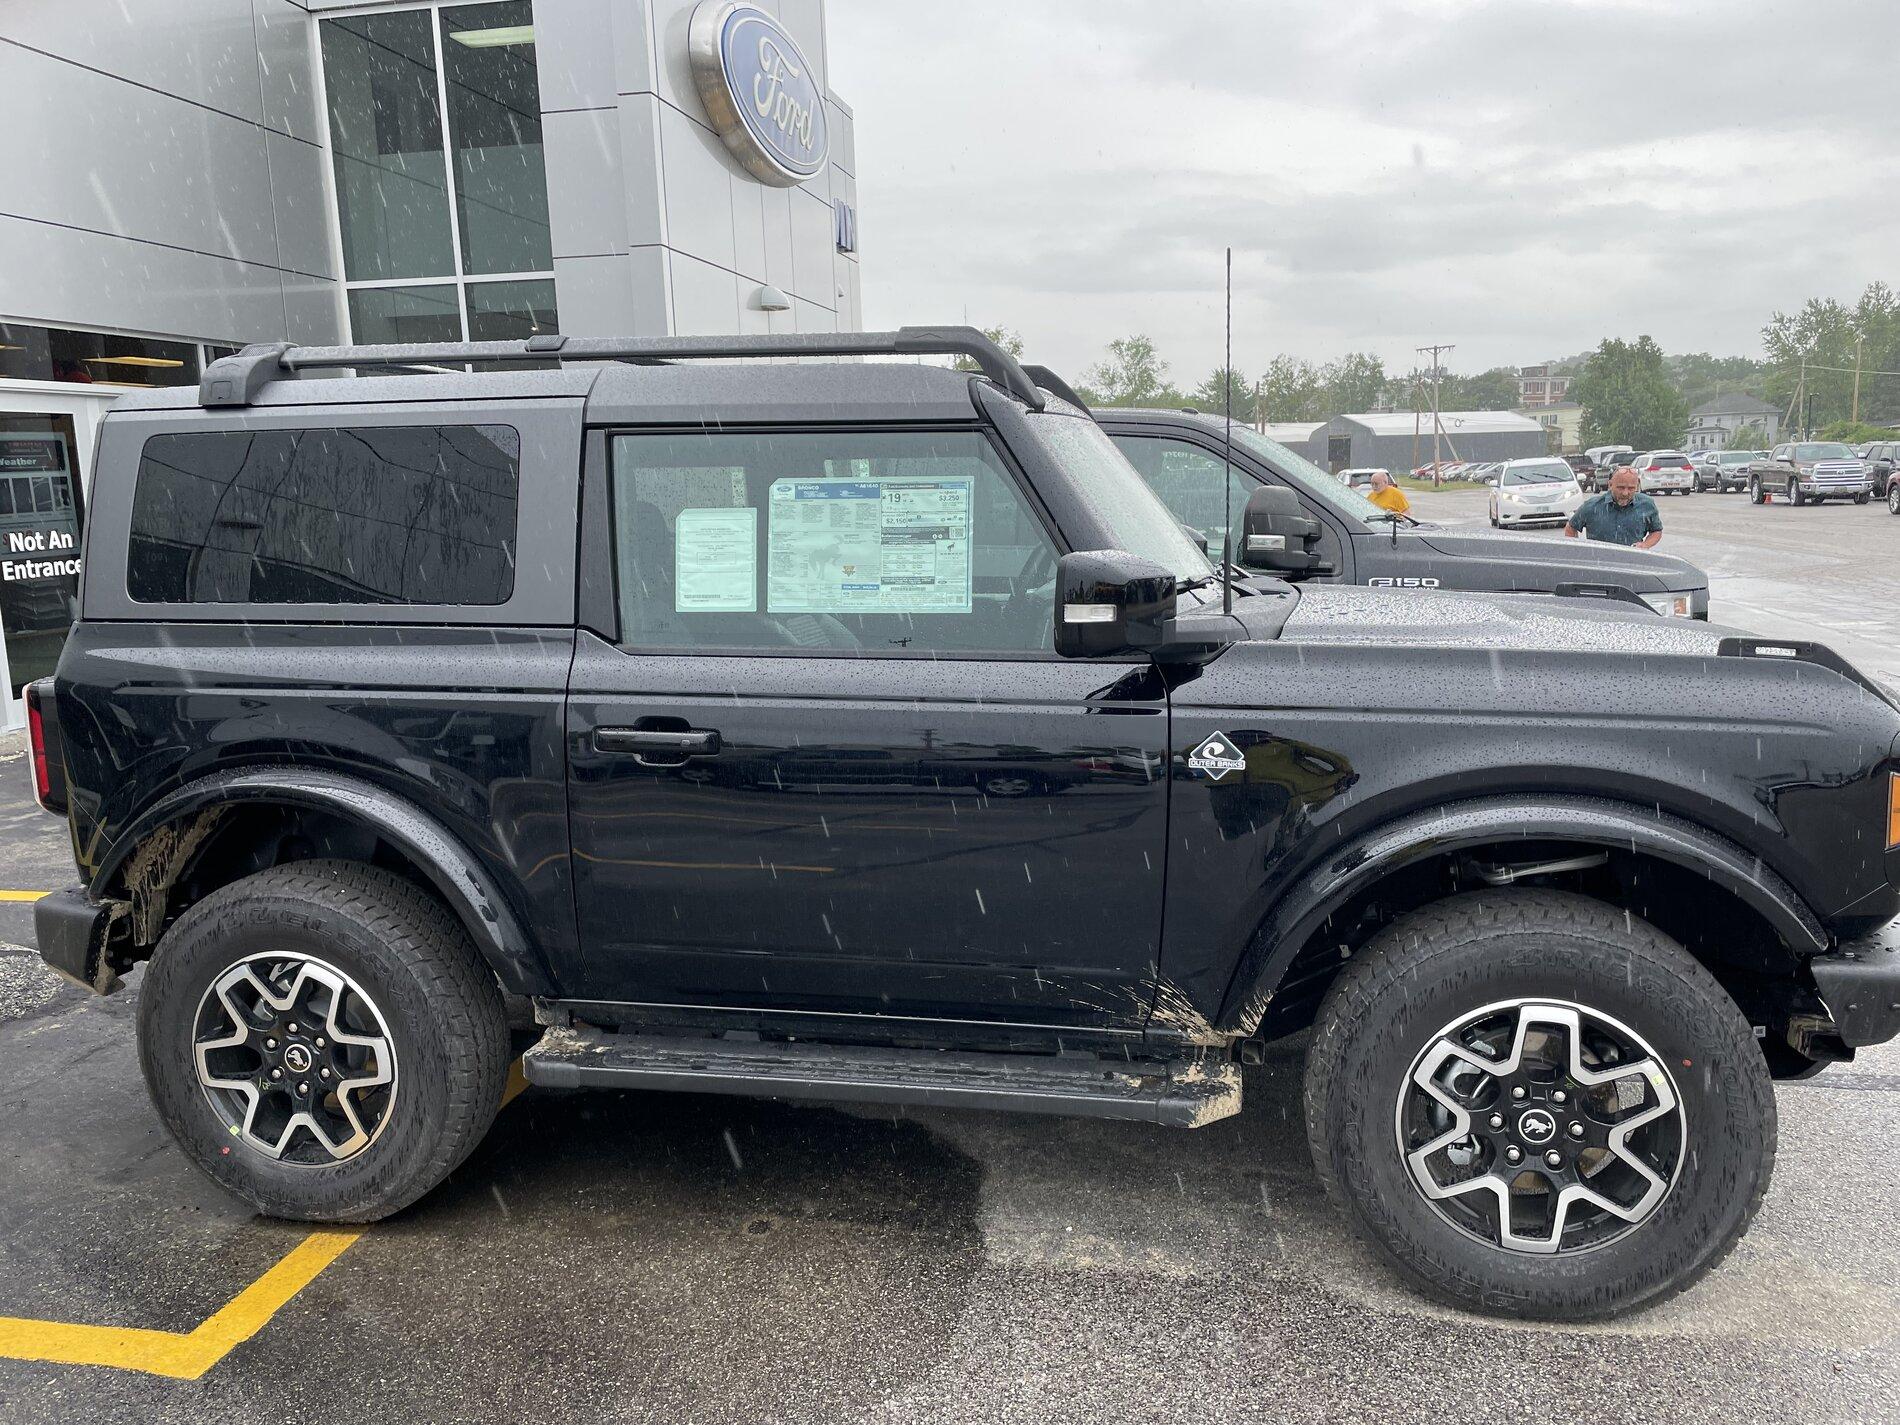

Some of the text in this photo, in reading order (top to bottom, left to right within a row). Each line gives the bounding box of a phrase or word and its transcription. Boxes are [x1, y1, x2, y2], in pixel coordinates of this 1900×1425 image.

[754, 36, 815, 151] Ford
[888, 493, 901, 503] 19
[9, 531, 45, 553] Not
[48, 530, 74, 550] An
[1190, 759, 1244, 768] OUTER BANKS
